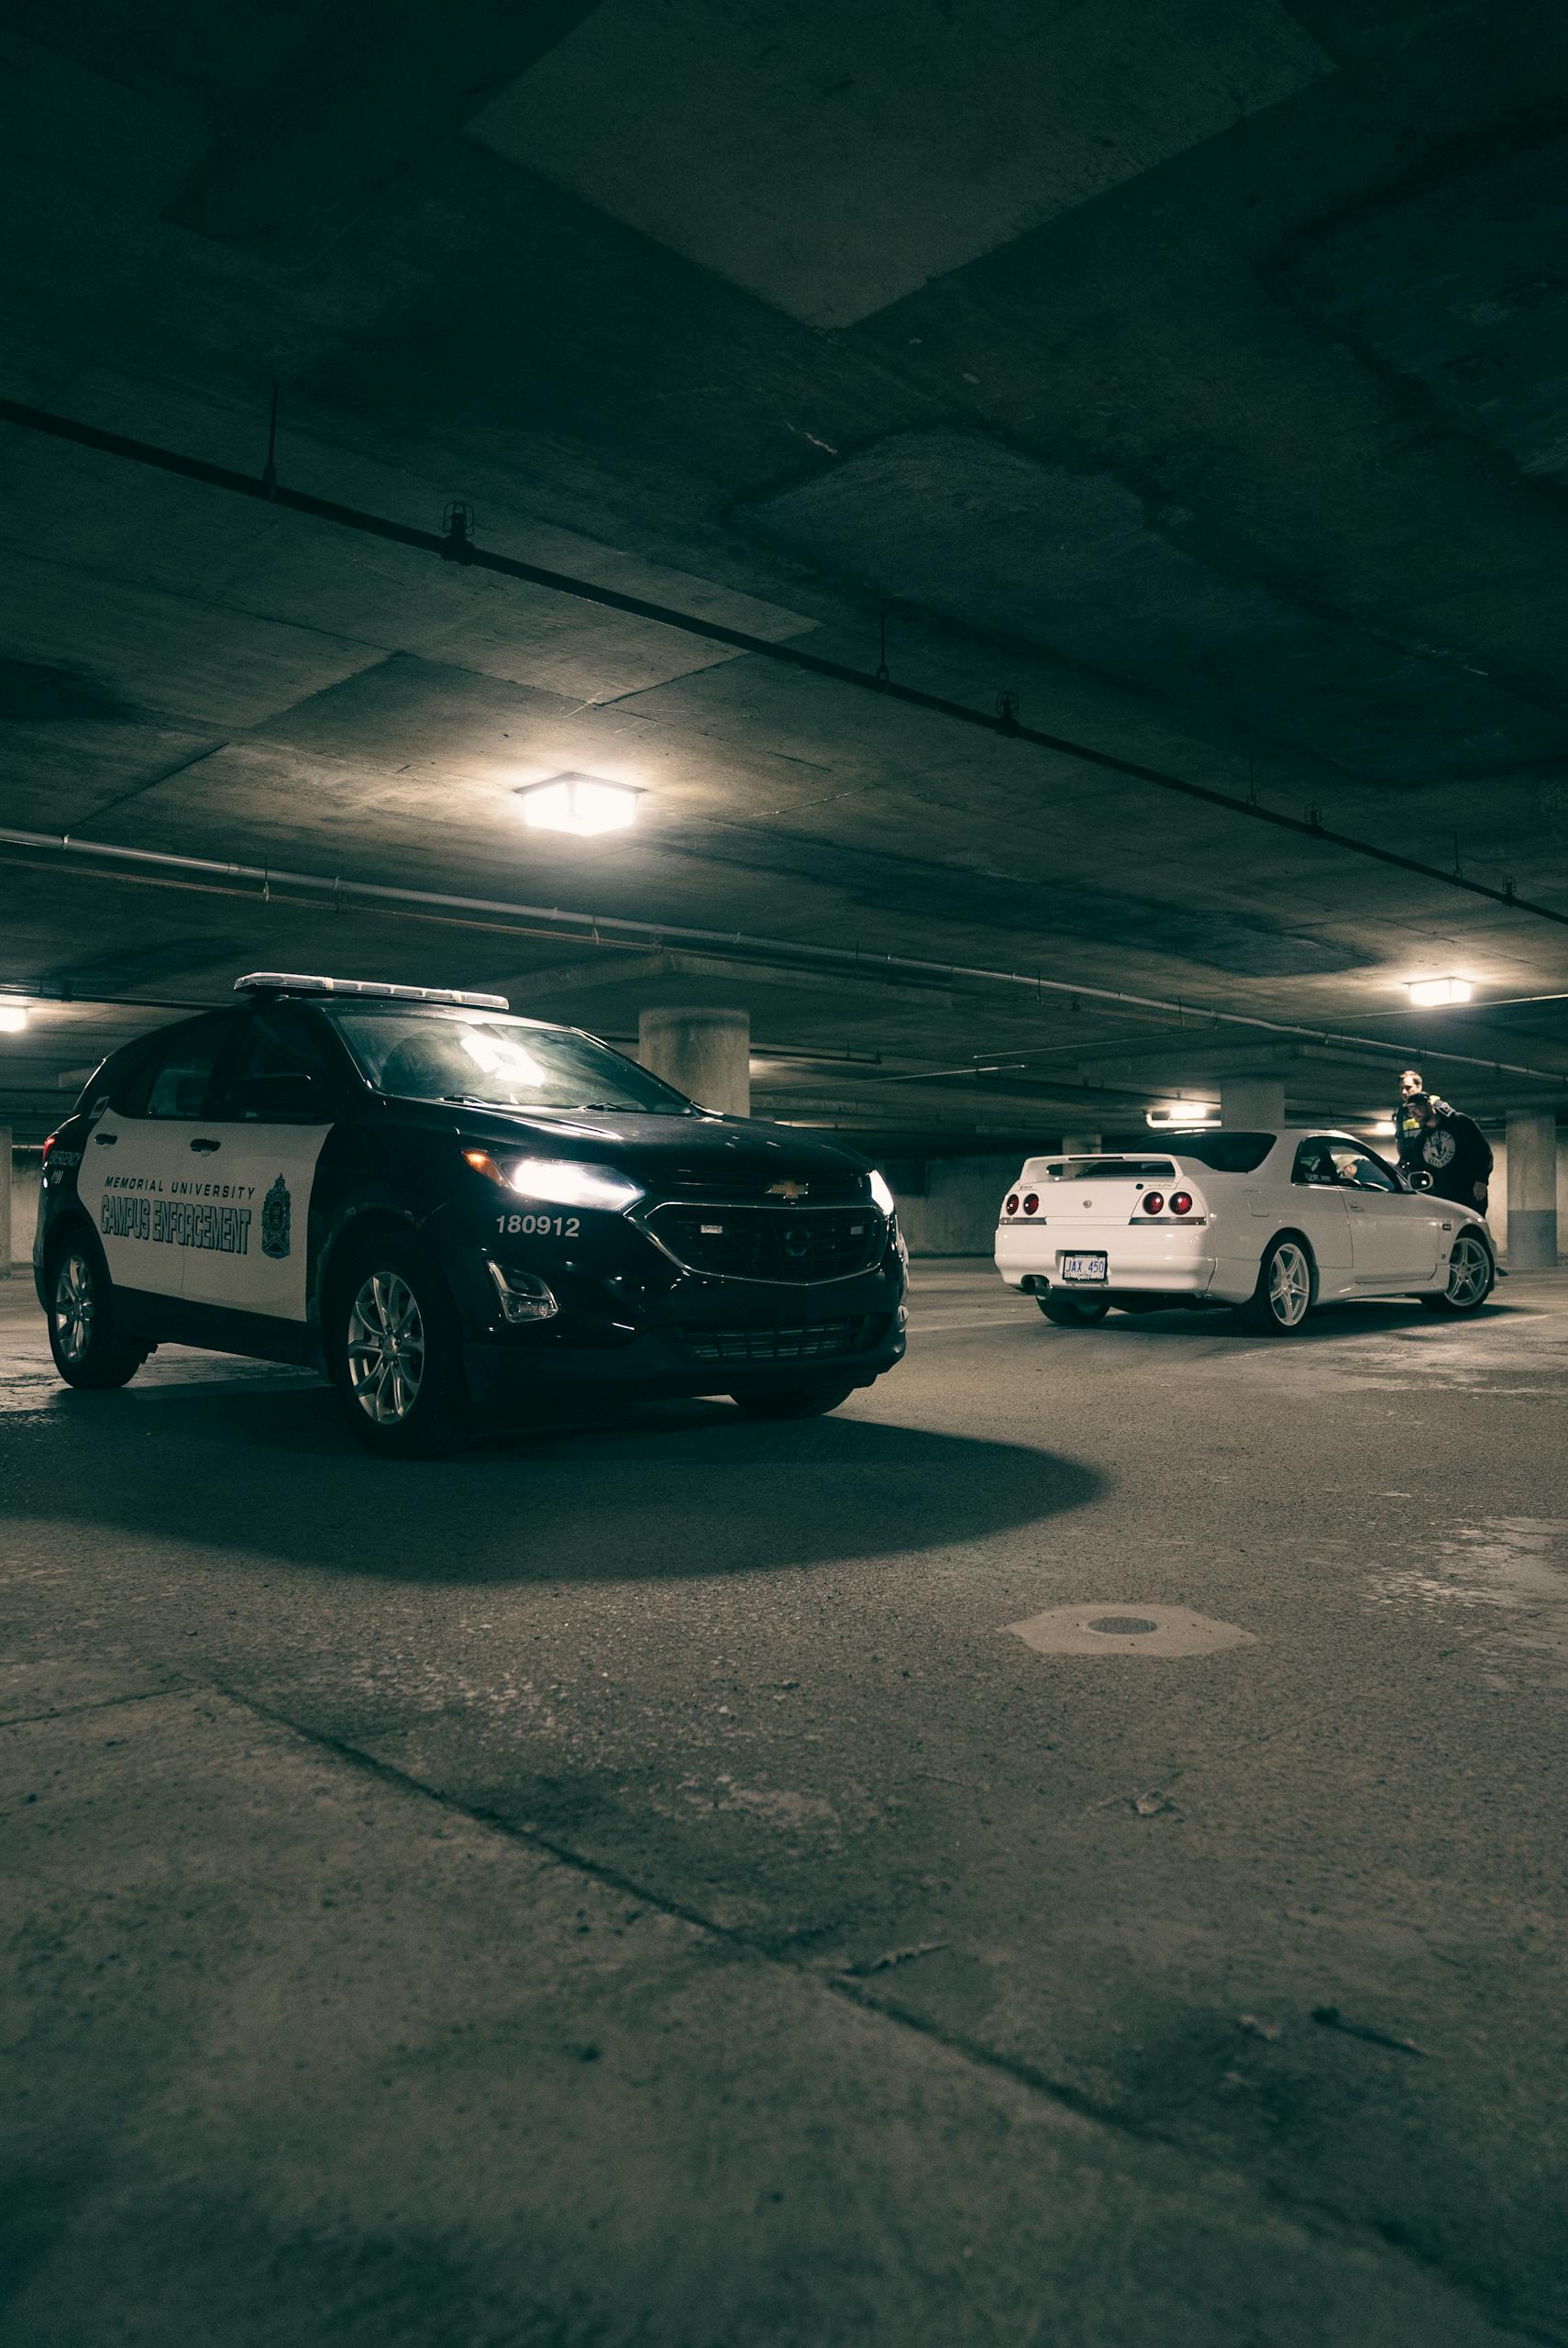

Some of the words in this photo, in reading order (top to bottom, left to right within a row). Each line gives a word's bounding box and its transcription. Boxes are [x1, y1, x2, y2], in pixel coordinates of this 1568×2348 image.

[105, 1175, 163, 1192] MEMORIAL
[171, 1180, 256, 1200] UNIVERSITY
[101, 1194, 150, 1240] CAMPUS
[152, 1200, 252, 1256] ENFORCEMENT
[496, 1214, 581, 1237] 180912
[1066, 1260, 1083, 1273] JAX
[1088, 1261, 1104, 1273] 450
